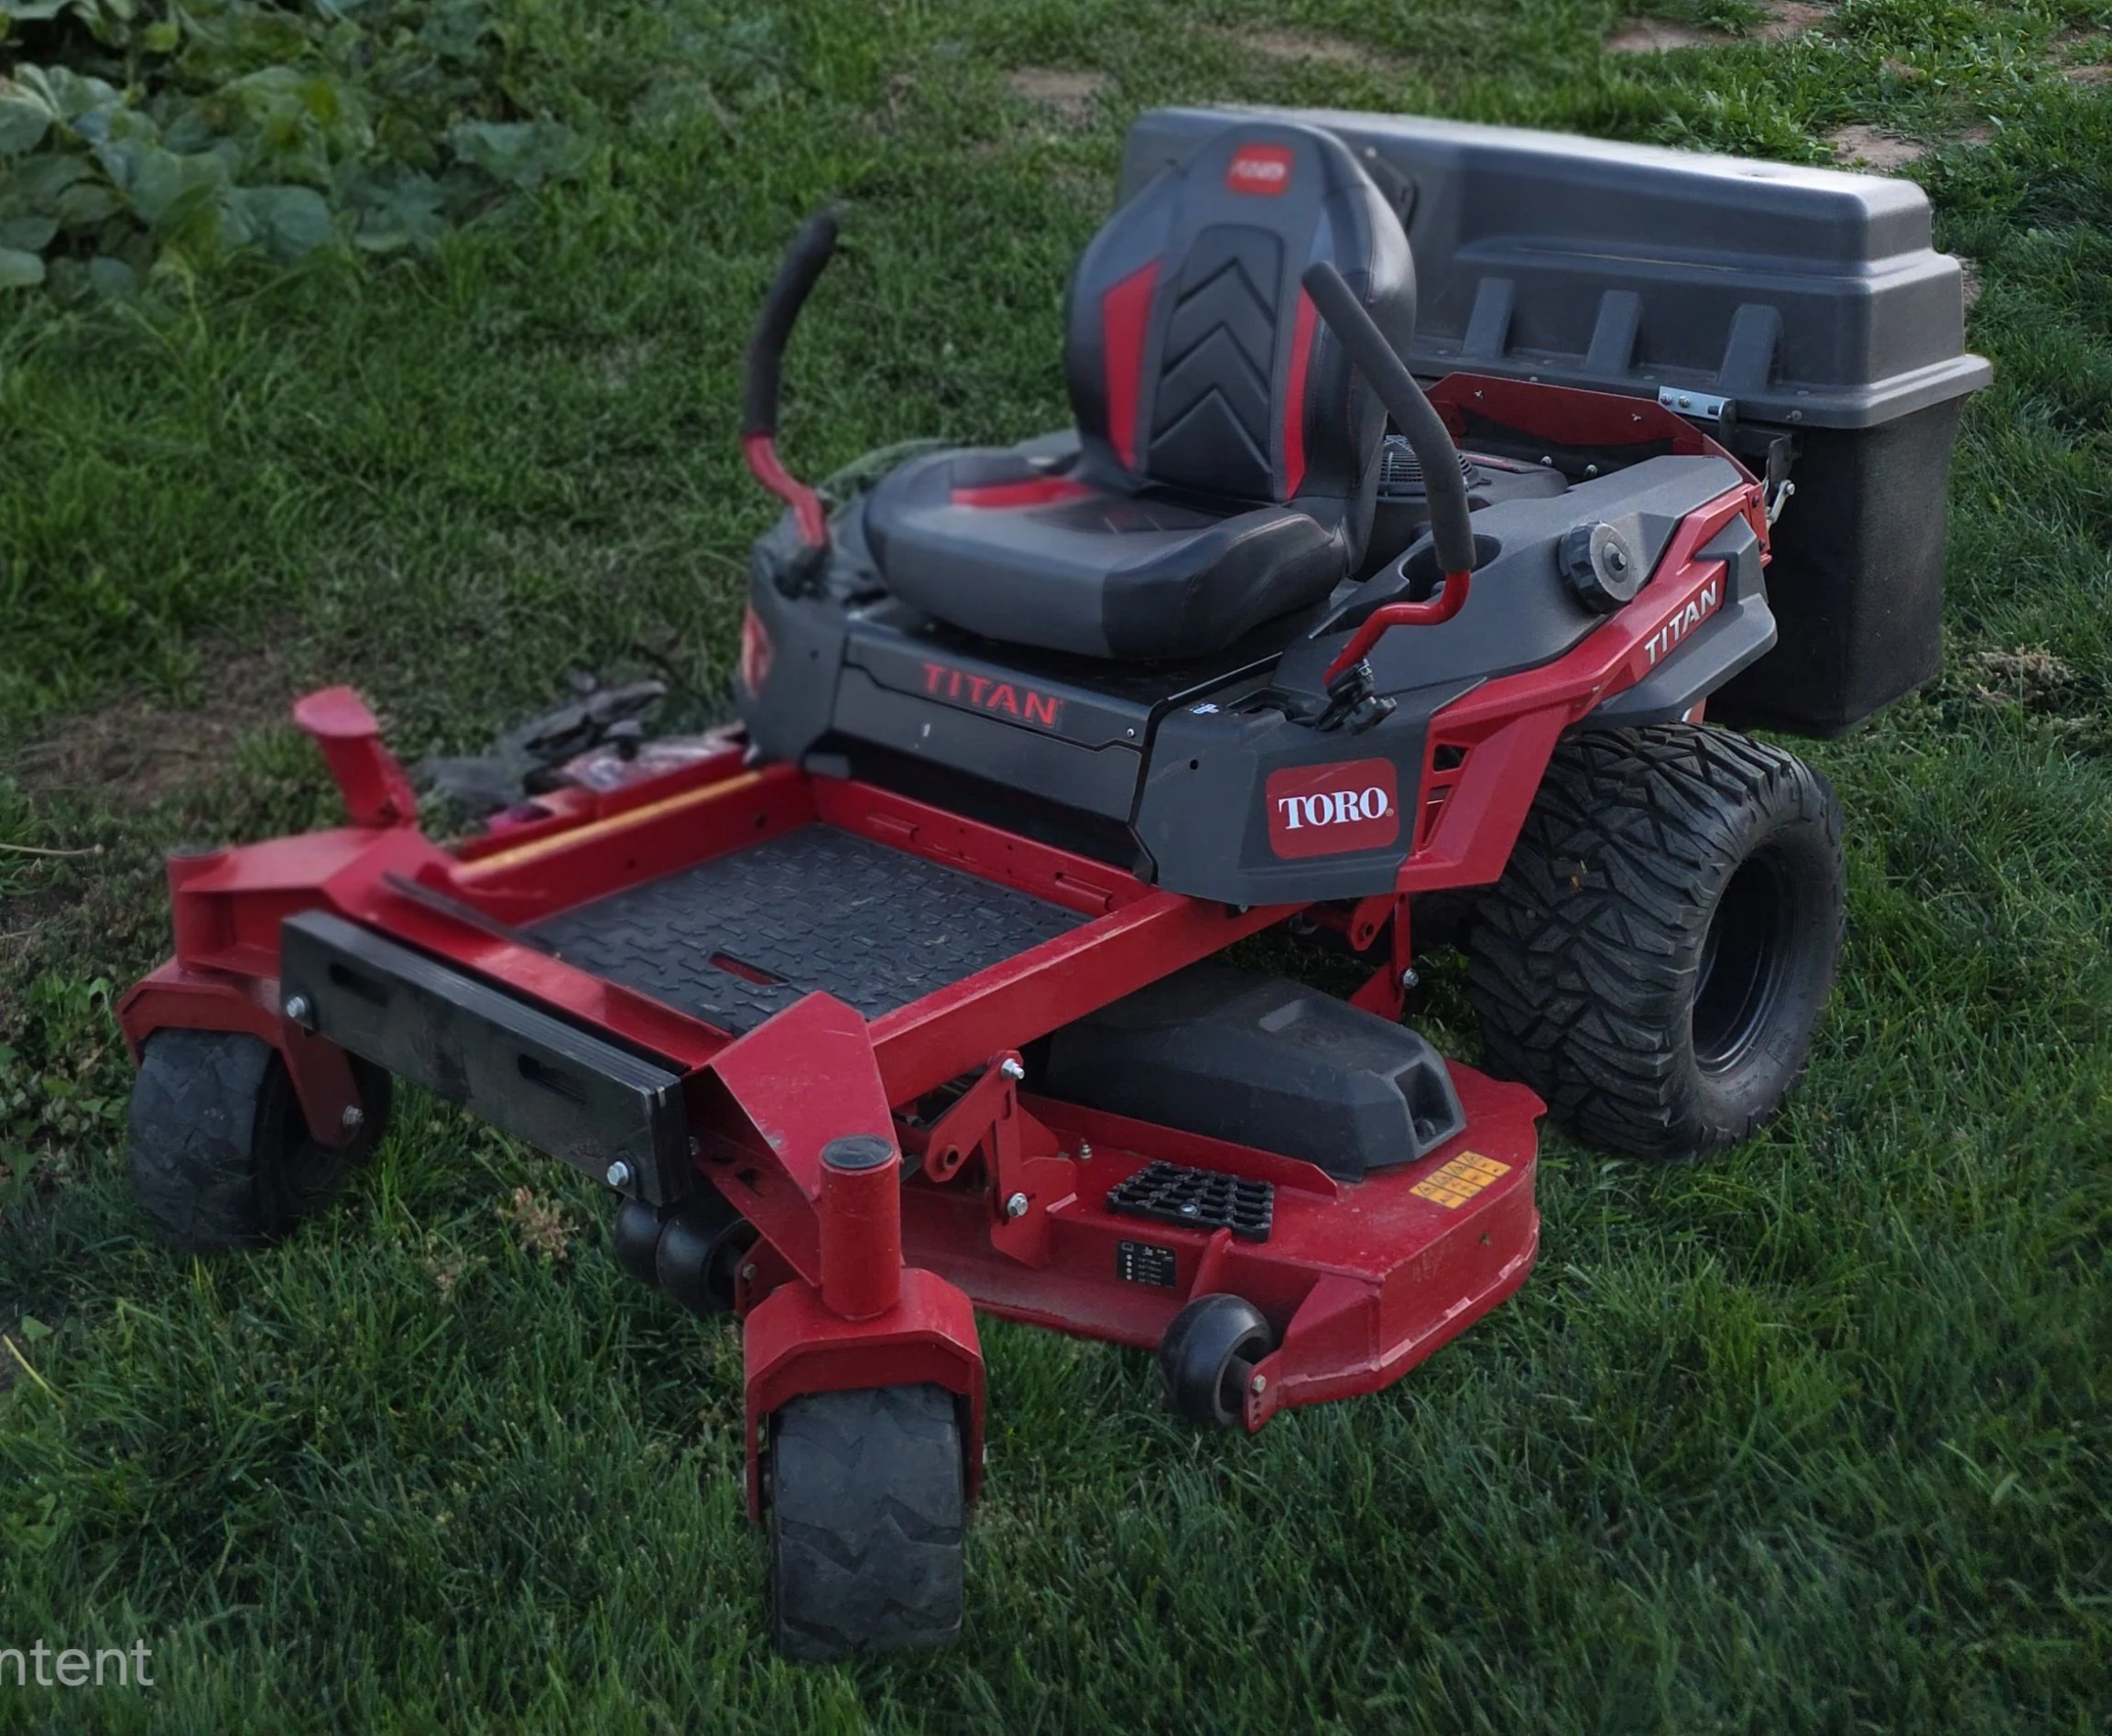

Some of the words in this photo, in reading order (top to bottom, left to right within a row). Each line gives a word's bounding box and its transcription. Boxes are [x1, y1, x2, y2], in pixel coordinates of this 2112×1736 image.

[1644, 579, 1716, 666] TITAN
[922, 662, 1058, 727] TITAN
[1278, 787, 1388, 830] TORO
